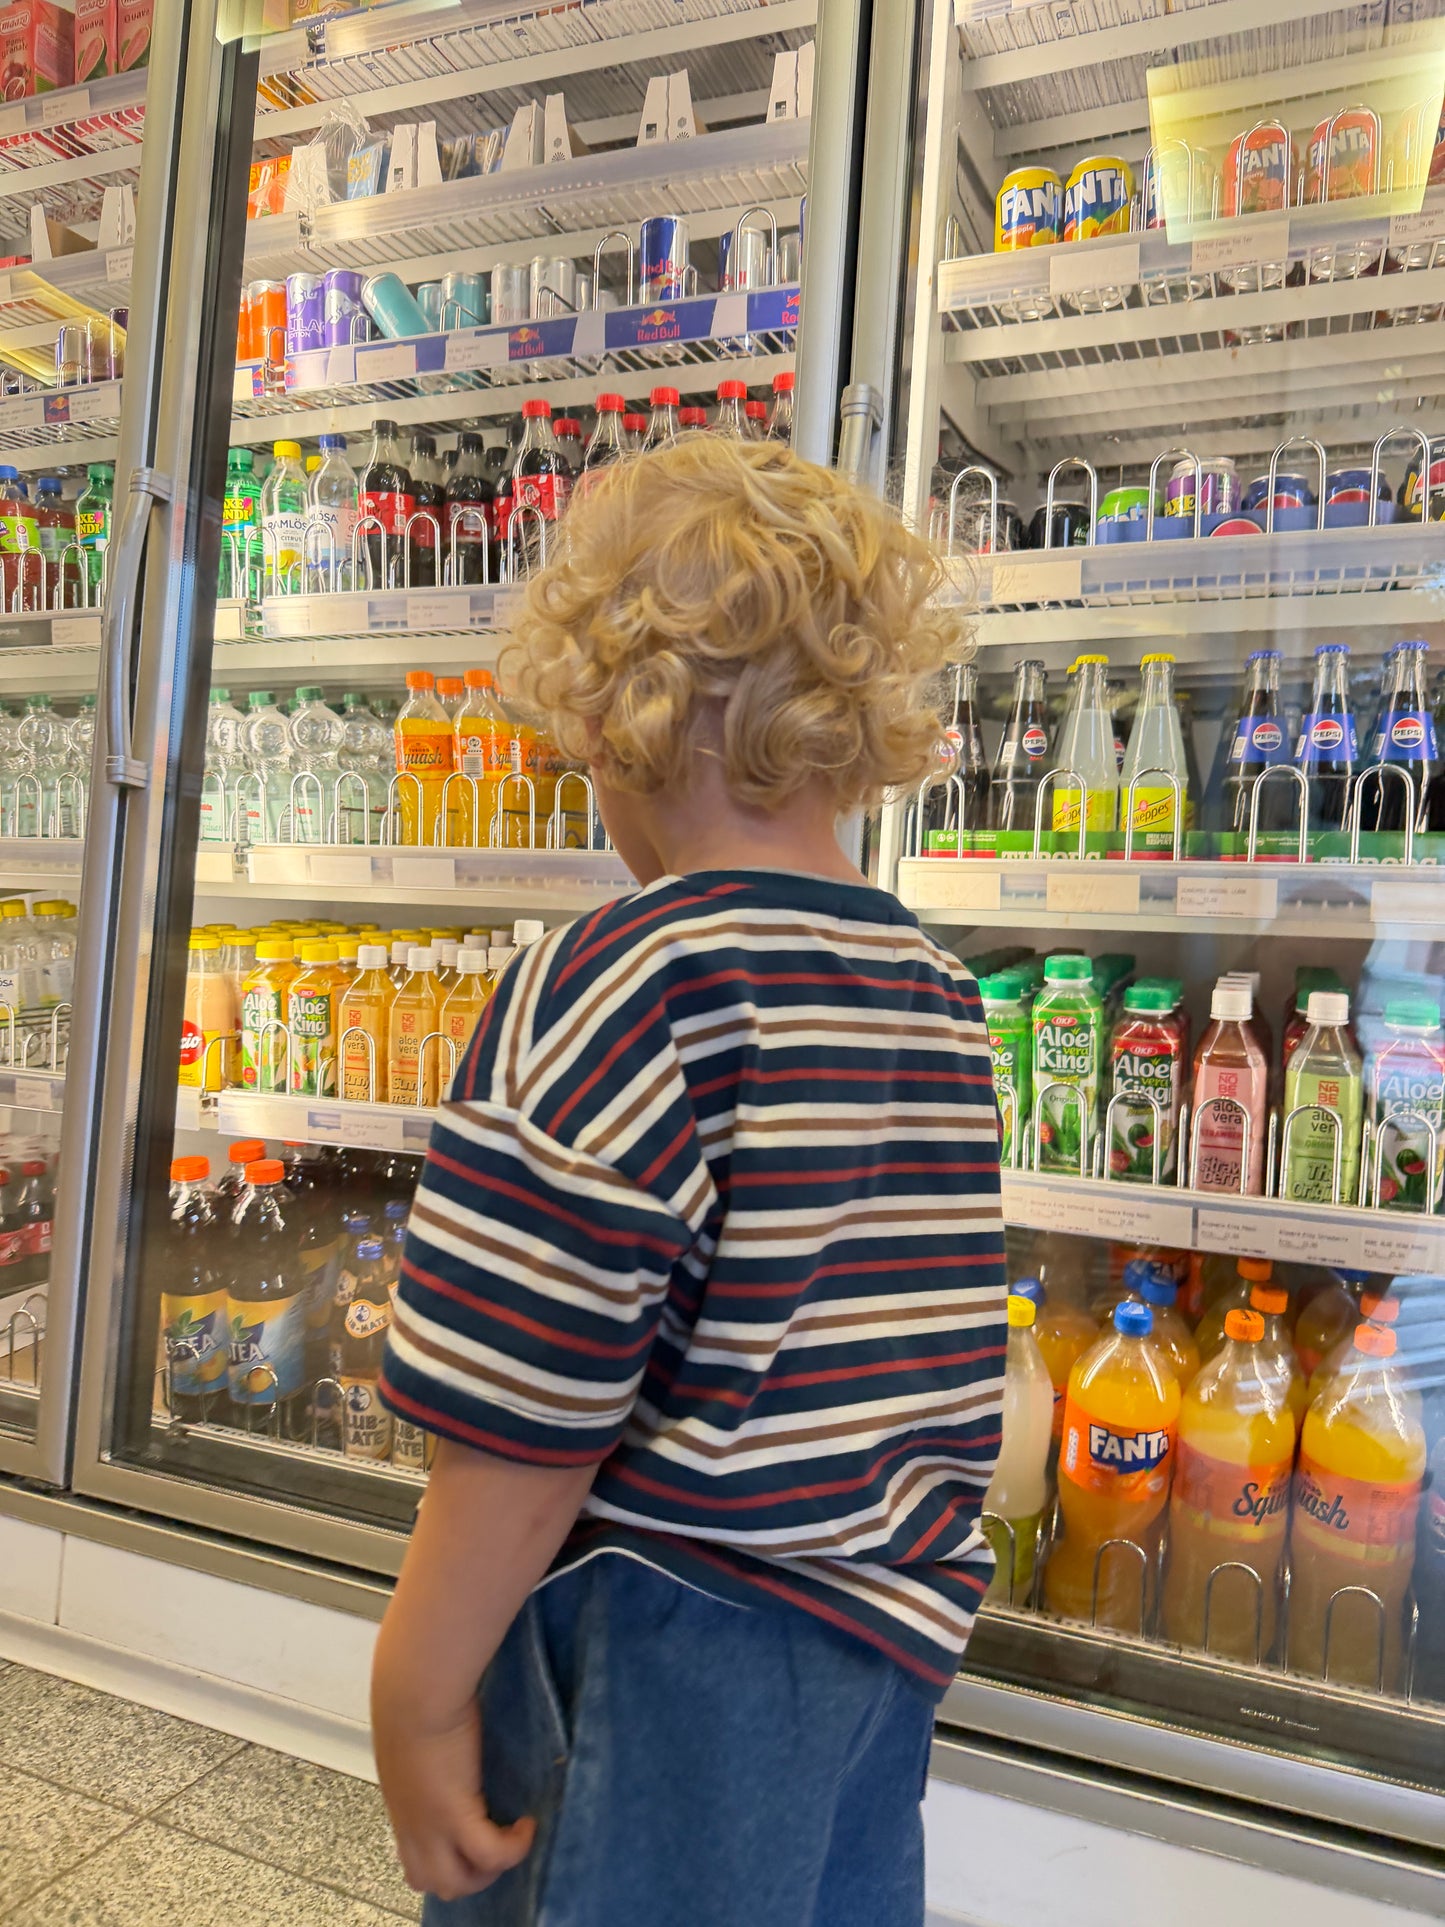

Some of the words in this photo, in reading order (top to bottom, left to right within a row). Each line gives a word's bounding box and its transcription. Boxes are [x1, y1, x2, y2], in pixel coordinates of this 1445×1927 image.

[660, 325, 681, 338] Bull
[1255, 733, 1281, 742] PEPSI
[1313, 731, 1342, 740] PEPSI
[1394, 729, 1423, 737] PEPSI
[399, 1035, 418, 1046] aloe
[1039, 1026, 1090, 1048] Aloe
[399, 1045, 419, 1055] vera
[1062, 1047, 1090, 1056] vera
[1040, 1047, 1091, 1073] King
[1116, 1055, 1170, 1079] Aloe
[1141, 1077, 1169, 1087] vera
[1383, 1076, 1443, 1101] Aloe
[1212, 1112, 1242, 1125] vera
[1311, 1121, 1335, 1134] ver
[1089, 1423, 1169, 1463] FANTA
